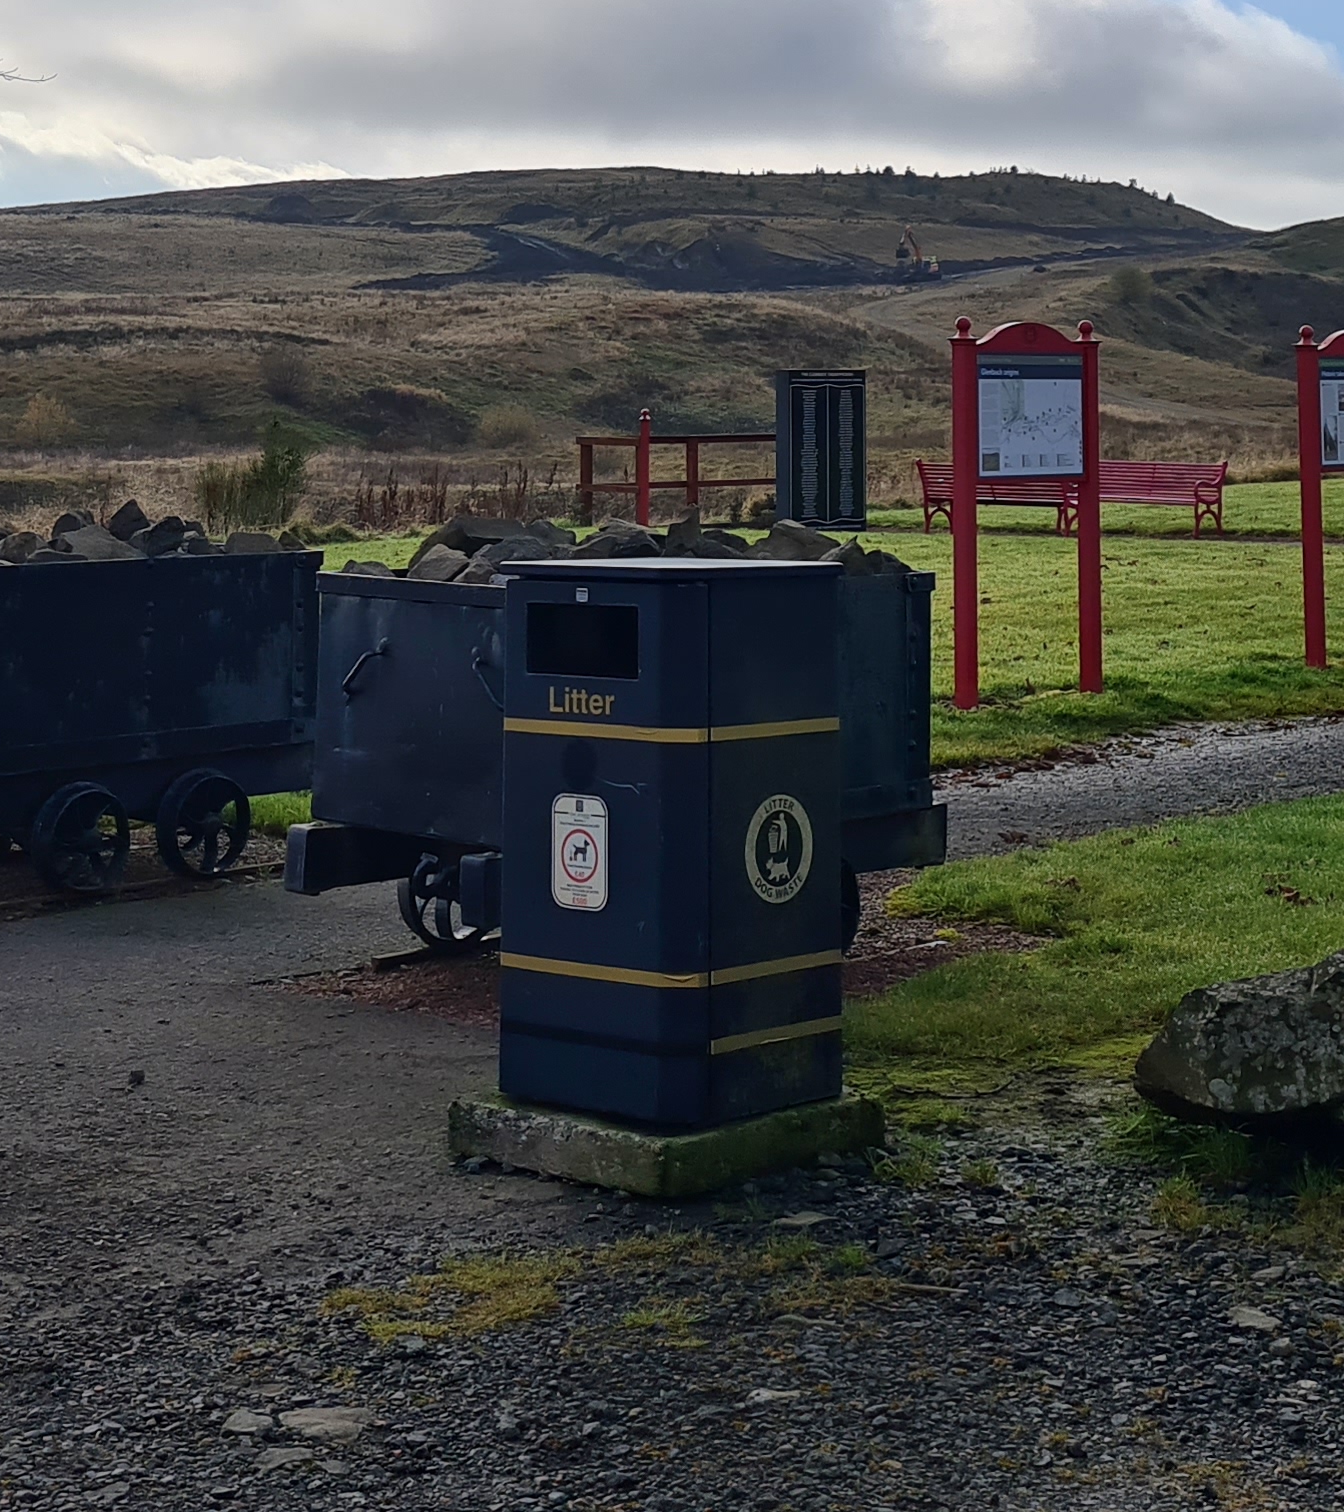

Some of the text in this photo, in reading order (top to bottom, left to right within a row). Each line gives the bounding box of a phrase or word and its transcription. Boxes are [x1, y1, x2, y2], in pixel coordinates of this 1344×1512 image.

[549, 686, 615, 715] Litter
[764, 798, 794, 814] LITTER
[754, 872, 803, 899] DOG WASTE
